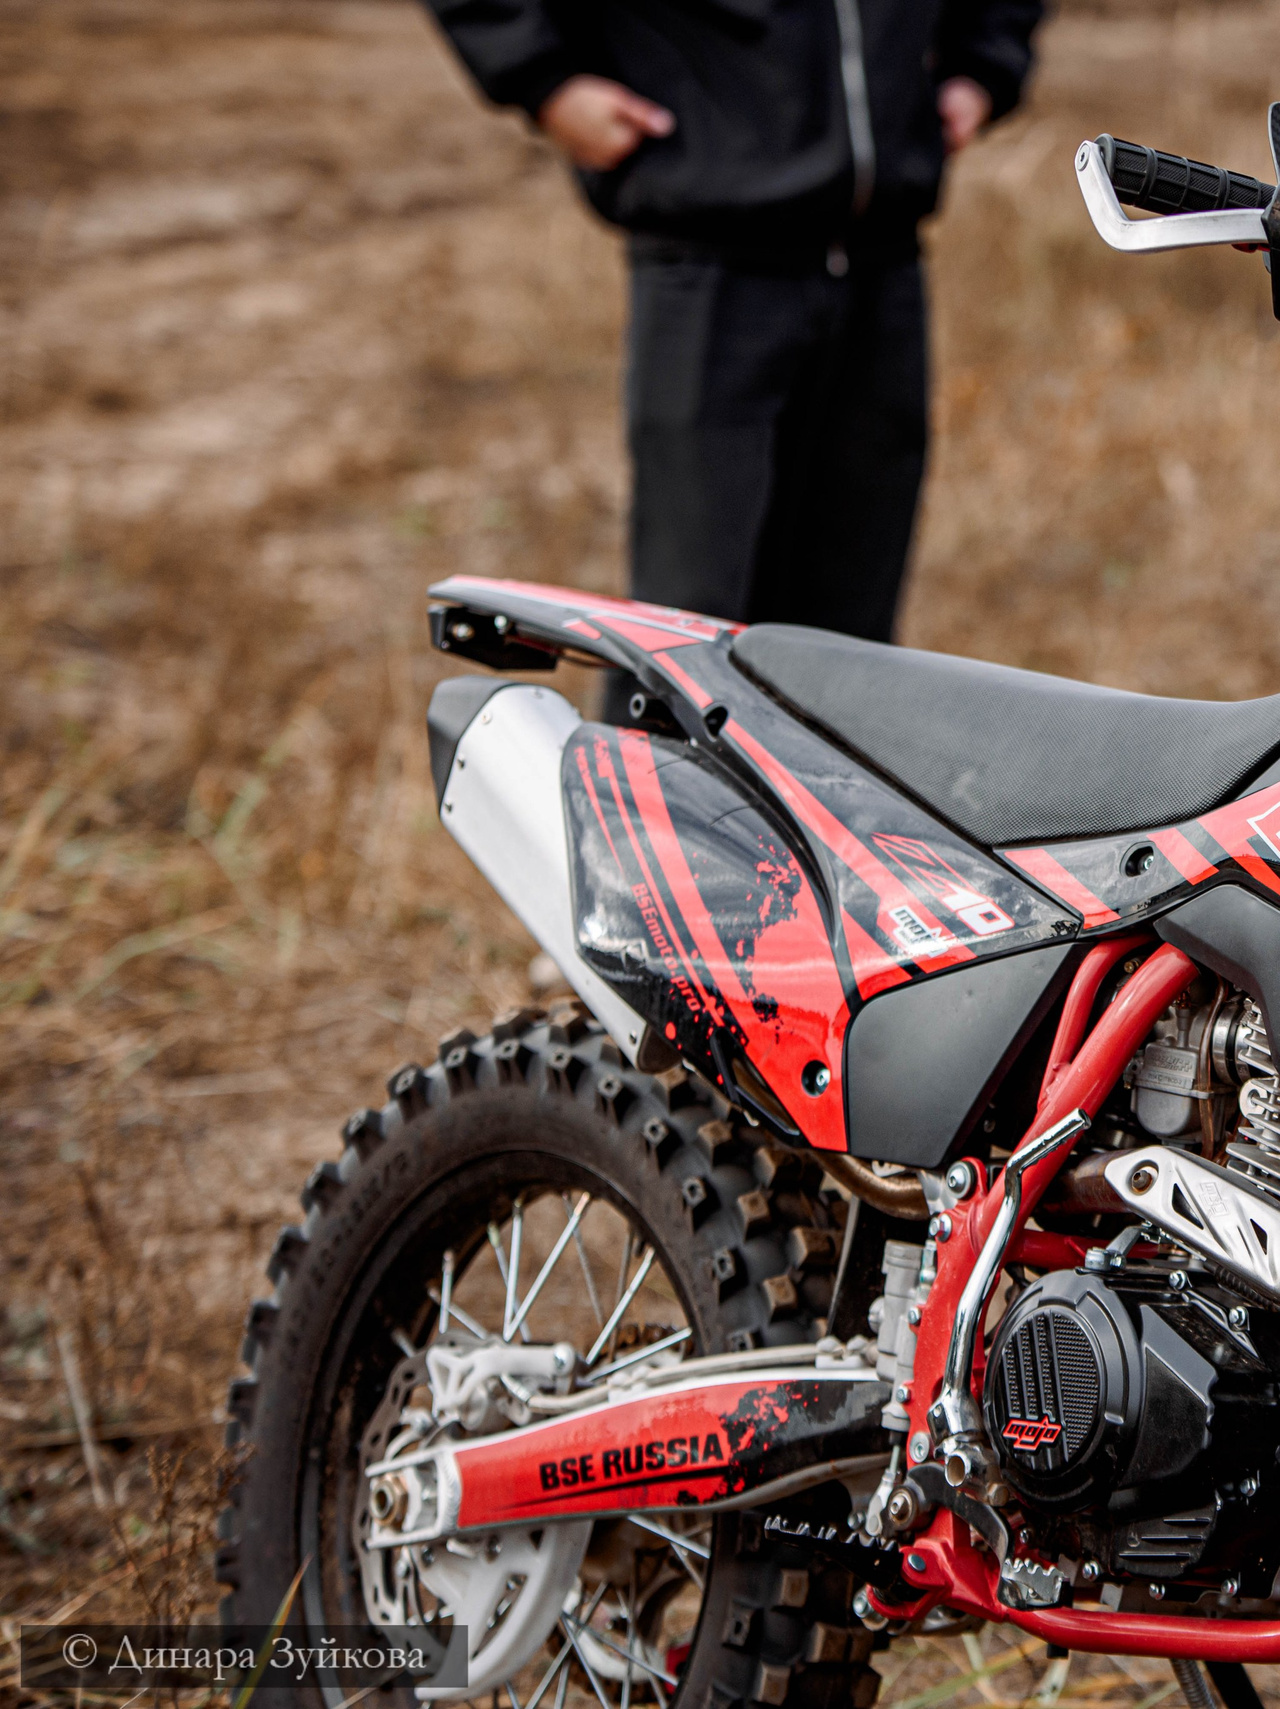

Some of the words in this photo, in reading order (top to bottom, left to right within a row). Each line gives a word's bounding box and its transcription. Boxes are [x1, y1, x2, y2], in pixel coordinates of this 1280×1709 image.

[631, 882, 701, 1012] BSEmoto.pro
[539, 1454, 595, 1491] BSE
[602, 1433, 724, 1479] RUSSIA
